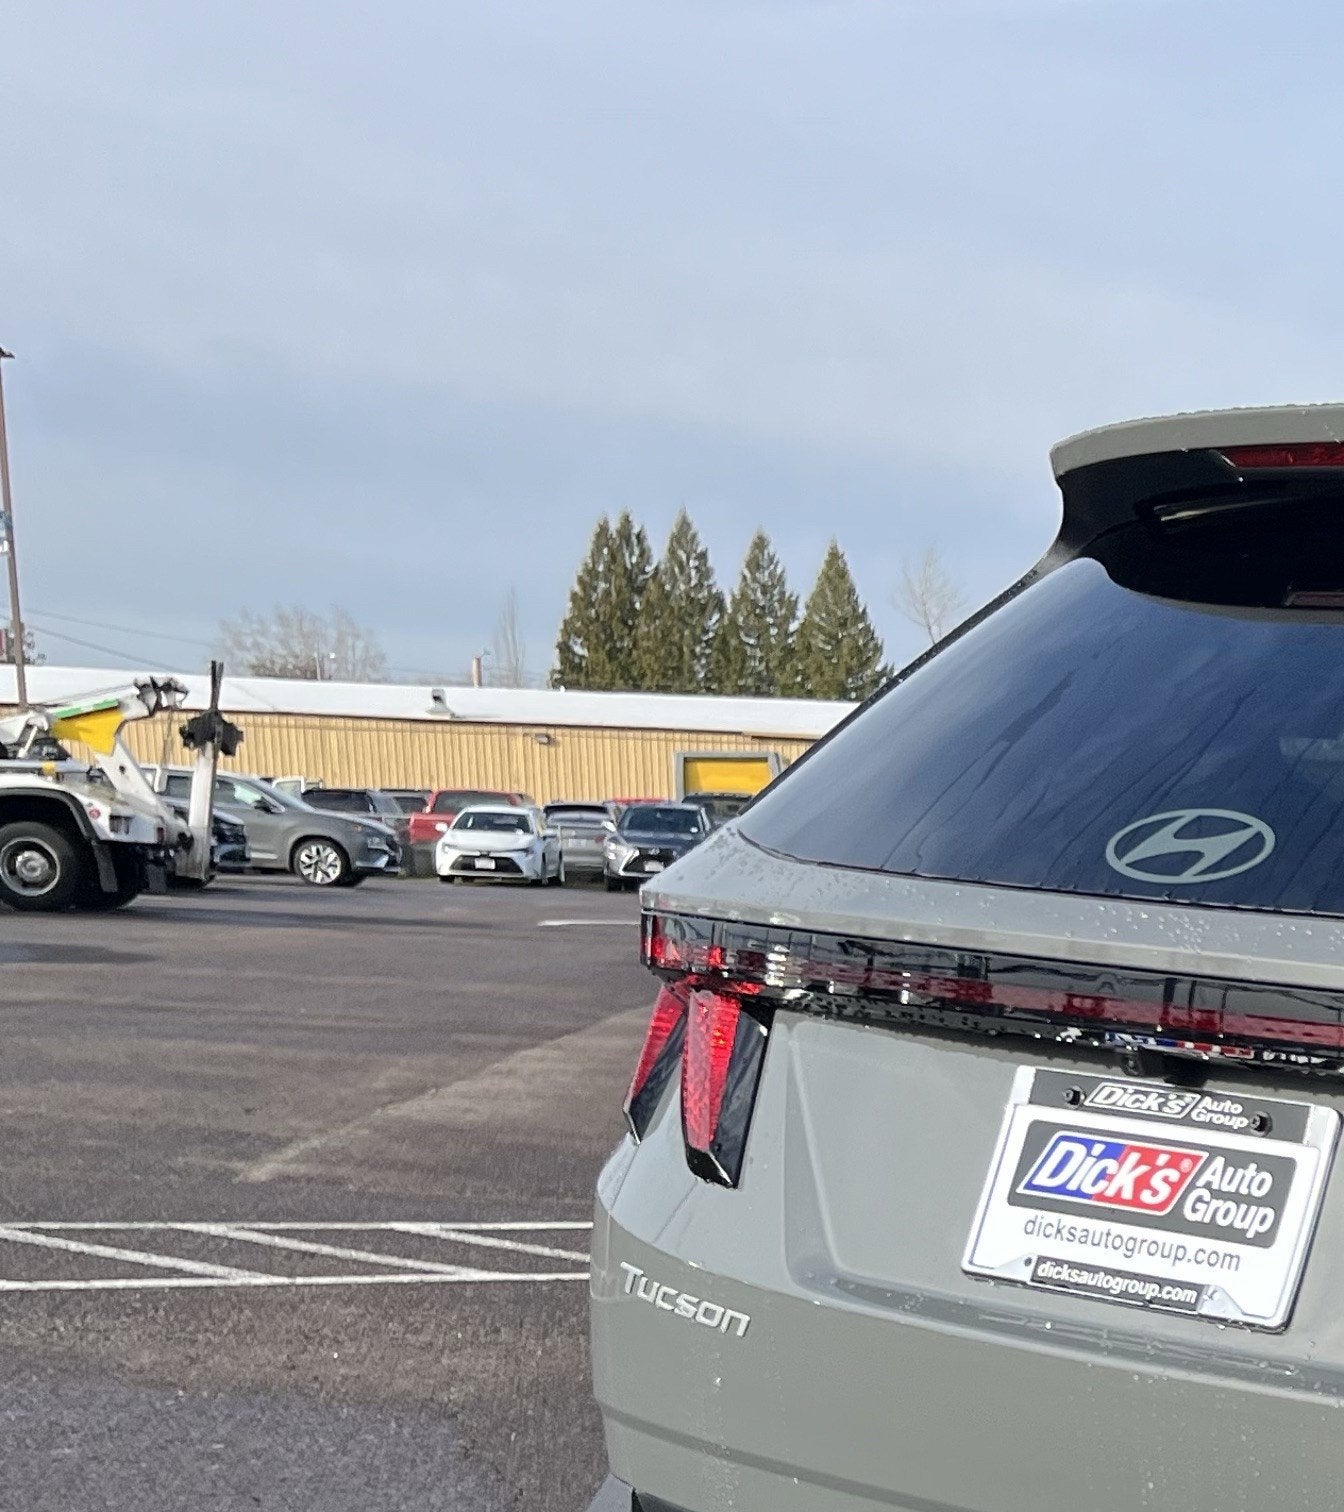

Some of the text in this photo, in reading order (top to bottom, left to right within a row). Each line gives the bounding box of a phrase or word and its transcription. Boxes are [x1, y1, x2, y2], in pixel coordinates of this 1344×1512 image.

[1093, 1085, 1187, 1115] Dick's
[1191, 1108, 1249, 1129] Group
[1197, 1096, 1244, 1115] Auto
[1032, 1140, 1182, 1206] Dick's
[1195, 1156, 1273, 1198] Auto
[1183, 1187, 1276, 1239] Group
[1024, 1214, 1241, 1272] dicksautogroup.com
[1037, 1260, 1197, 1305] dicksautogroup.com
